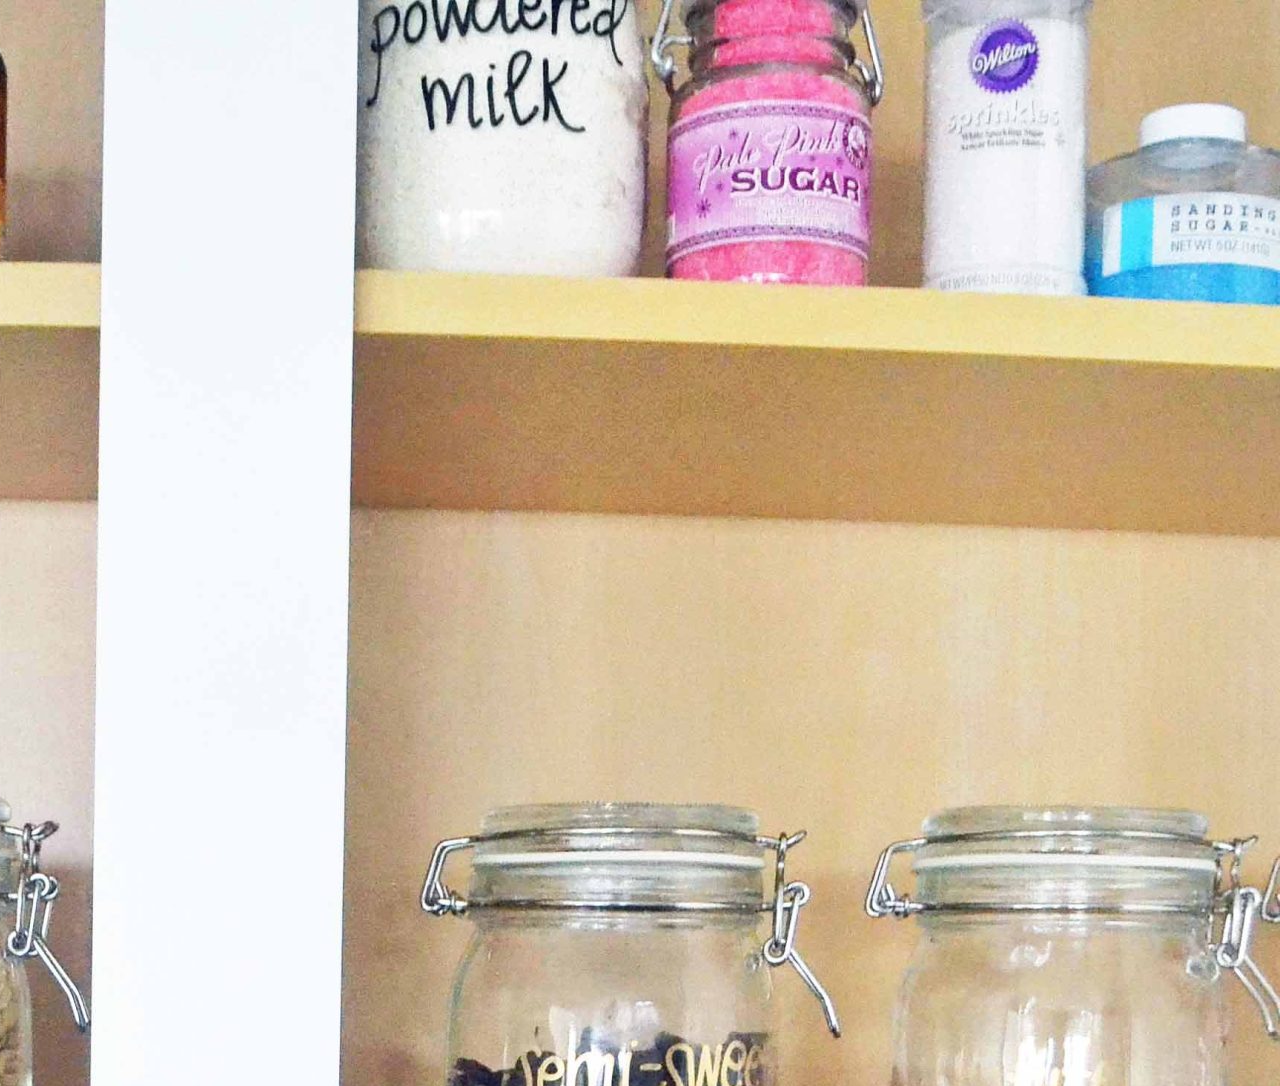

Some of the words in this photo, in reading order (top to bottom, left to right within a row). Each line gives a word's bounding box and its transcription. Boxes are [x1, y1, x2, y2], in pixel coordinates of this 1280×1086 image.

[366, 0, 627, 106] powdered
[972, 41, 1037, 75] Wilton
[421, 50, 586, 132] milk
[948, 99, 1060, 135] sprinkles
[693, 131, 760, 195] Pale
[764, 119, 842, 167] Pink
[730, 166, 860, 203] SUGAR
[1171, 203, 1276, 222] SANDING
